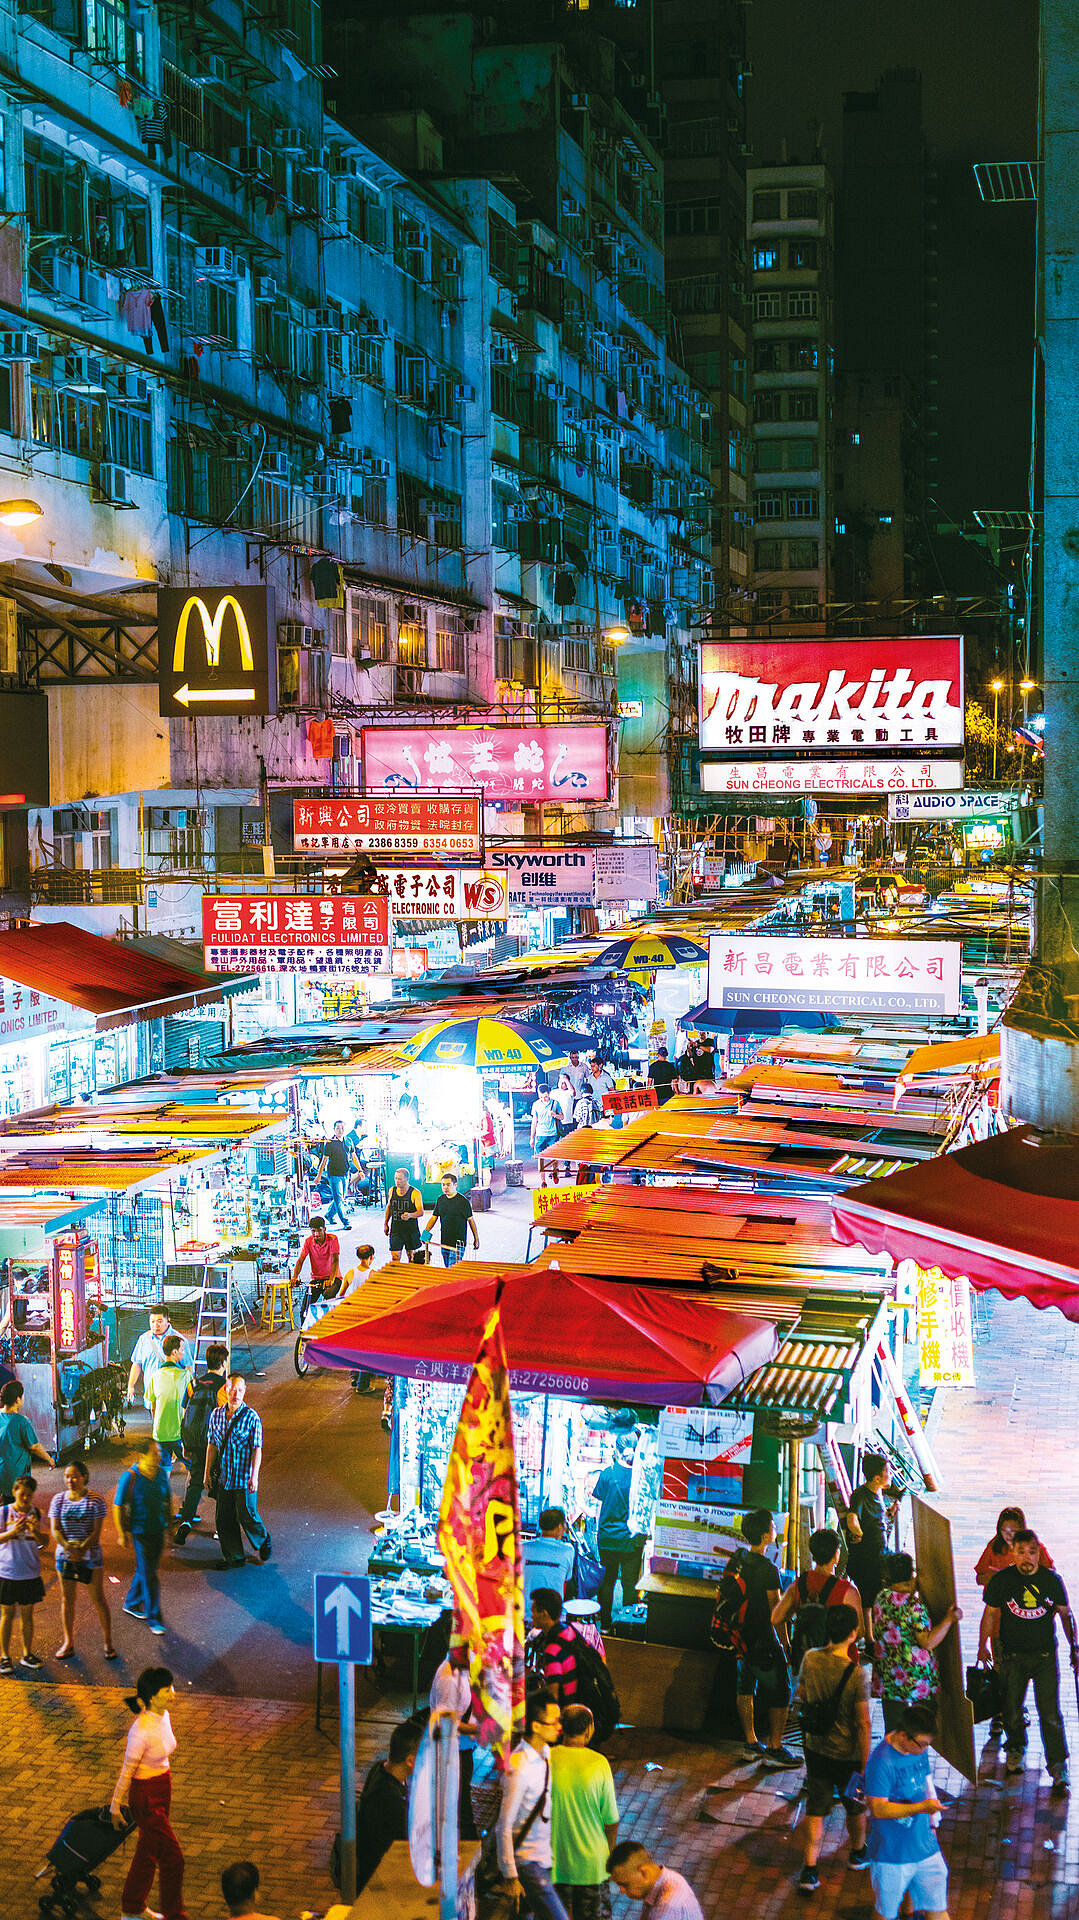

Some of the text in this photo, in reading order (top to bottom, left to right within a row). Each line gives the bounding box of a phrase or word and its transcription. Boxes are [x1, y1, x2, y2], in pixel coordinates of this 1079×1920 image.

[725, 725, 939, 745] 牧田牌 專業電動工具
[729, 764, 932, 780] 生昌電業有限公司
[726, 777, 937, 790] SUN CHEONG ELECTRICALS CO. LTD.
[959, 795, 999, 807] SPACE
[299, 804, 370, 828] 新興公司
[374, 820, 474, 831] 政府物資 法院封存
[368, 838, 474, 849] 2386 8359 6354 0653
[491, 852, 586, 870] Skyworth
[521, 872, 557, 887] 创维
[463, 883, 497, 910] WS
[210, 900, 313, 931] 富利達
[392, 902, 456, 915] ELECTRONIC CO.
[211, 932, 384, 943] FULIDAT ELECTRONICS LIMITED
[723, 948, 945, 981] 新昌電業有限公司
[726, 992, 750, 1002] SUN
[752, 992, 805, 1005] CHEONG
[808, 994, 885, 1007] ELECTRICAL
[914, 998, 940, 1009] LTD.
[608, 1093, 652, 1110] 電話咭
[678, 1504, 702, 1513] DIGITAL
